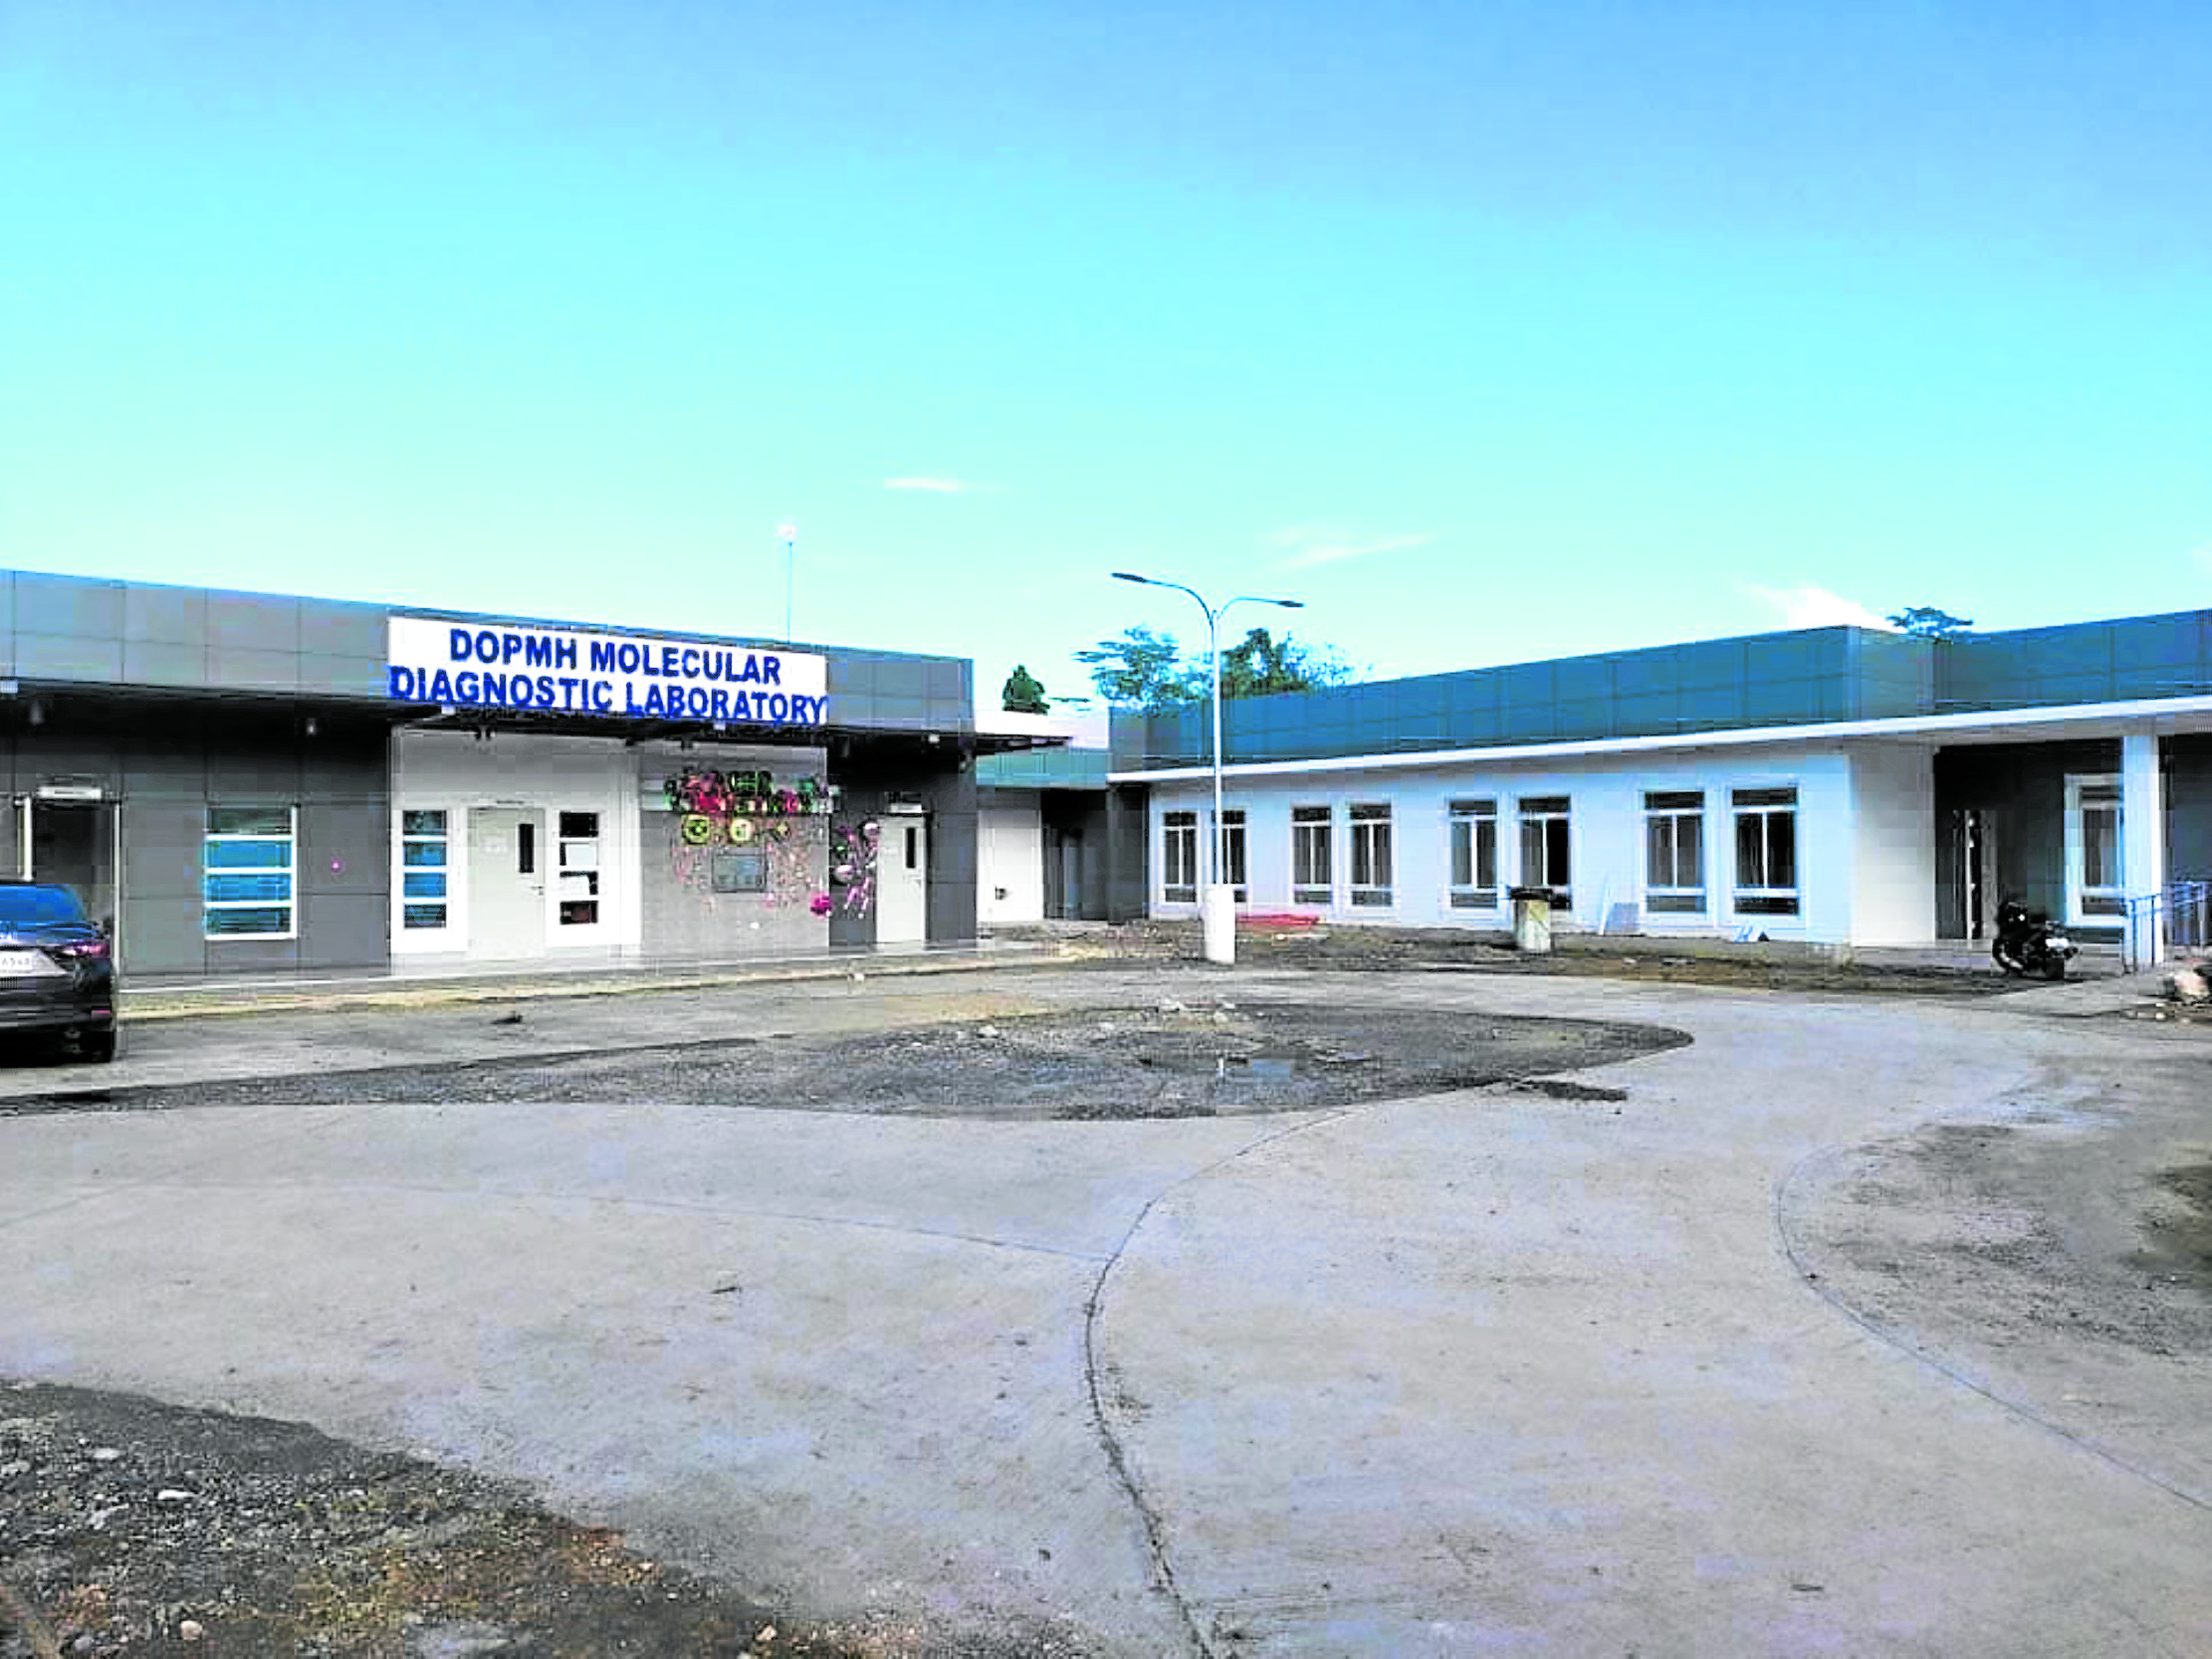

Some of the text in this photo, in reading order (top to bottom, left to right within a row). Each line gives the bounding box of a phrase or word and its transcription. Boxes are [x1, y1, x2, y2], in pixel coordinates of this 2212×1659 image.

[451, 628, 780, 685] DOPMH MOLECULAR
[389, 665, 828, 725] DIAGNOSTIC LABORATORY
